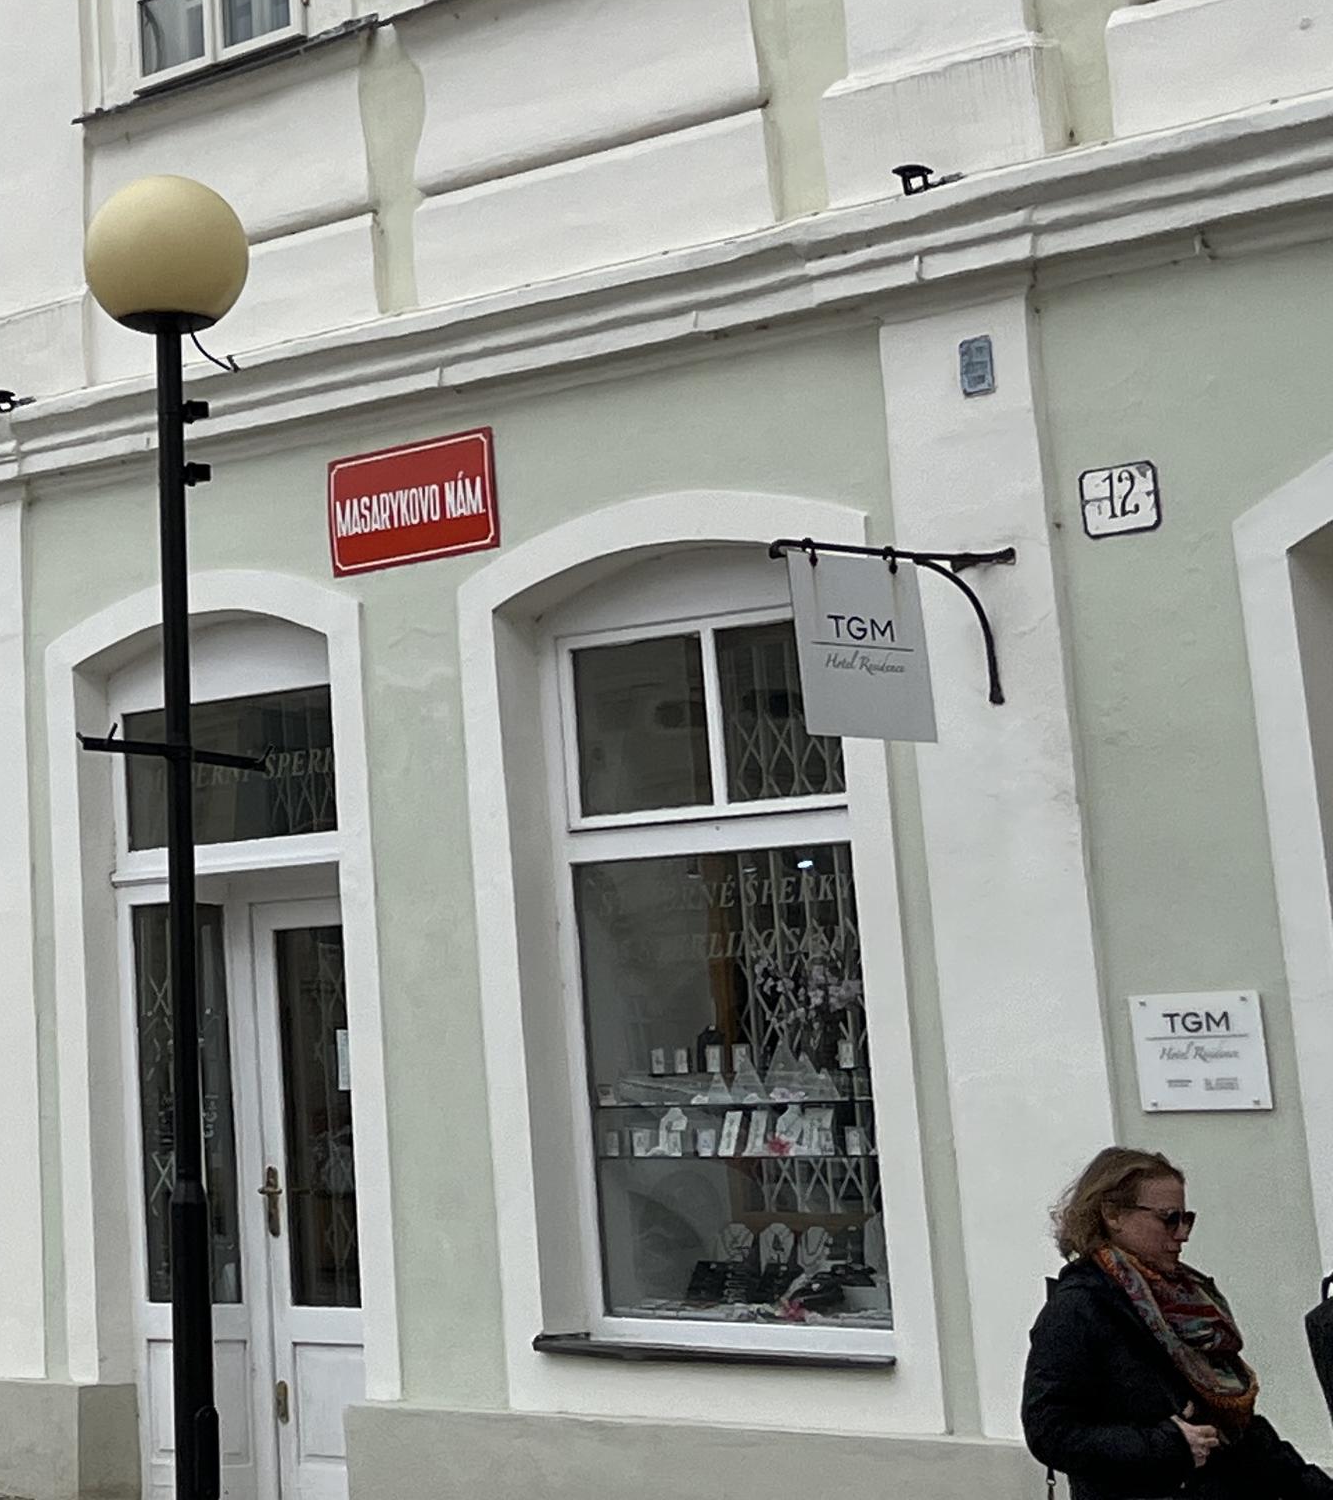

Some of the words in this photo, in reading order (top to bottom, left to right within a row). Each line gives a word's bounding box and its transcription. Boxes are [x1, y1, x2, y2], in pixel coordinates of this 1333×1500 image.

[336, 484, 440, 538] MASARYKOVO
[444, 470, 487, 519] NÁM.
[1101, 469, 1140, 520] 12
[827, 613, 896, 642] TGM
[824, 650, 858, 670] Hotel
[859, 652, 906, 675] Residence
[1162, 1011, 1231, 1033] TGM
